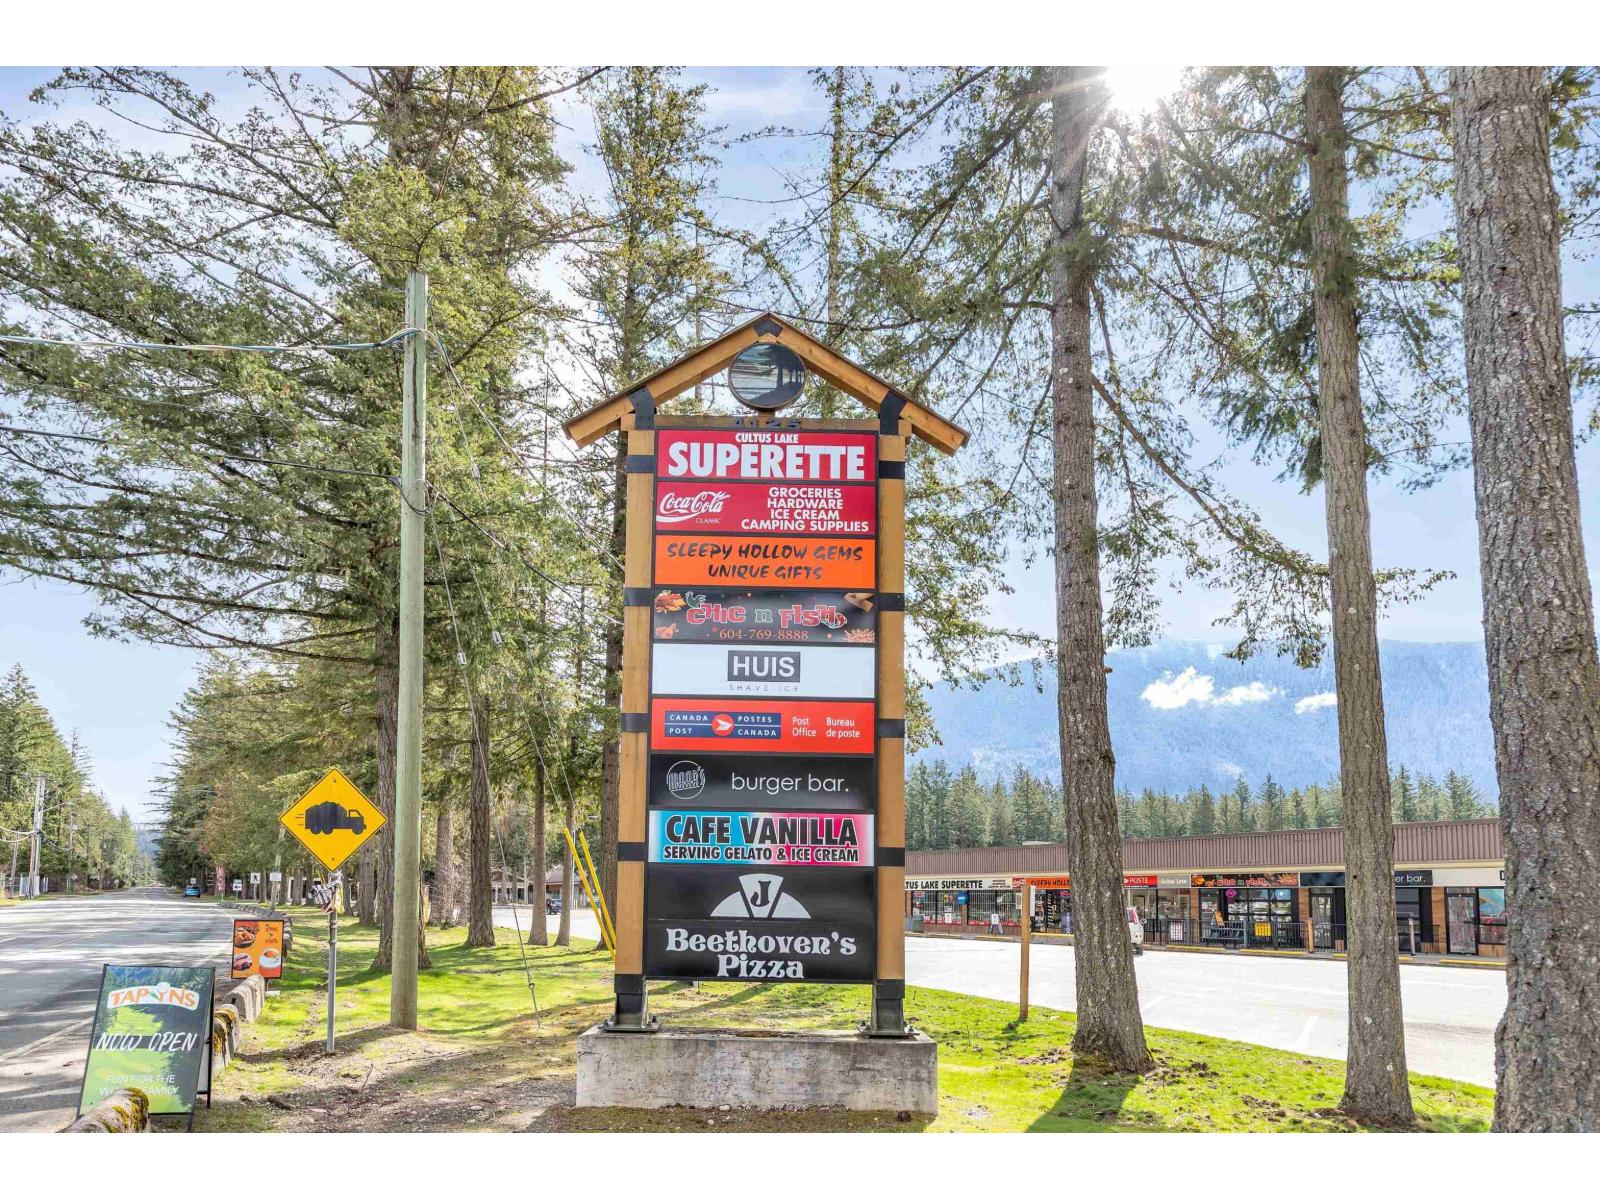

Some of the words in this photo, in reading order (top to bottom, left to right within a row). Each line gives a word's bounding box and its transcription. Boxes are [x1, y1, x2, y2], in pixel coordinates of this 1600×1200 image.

[735, 432, 772, 443] CULTUS
[774, 433, 799, 443] LAKE
[668, 441, 865, 480] SUPERETTE
[768, 487, 842, 499] GROCERIES
[767, 498, 843, 510] HARDWARE
[770, 509, 790, 520] ICE
[793, 510, 840, 521] CREAM
[741, 519, 805, 531] CAMPING
[809, 520, 869, 532] SUPPLIES
[667, 542, 733, 559] SLEEPY
[738, 543, 808, 559] HOLLOW
[813, 545, 863, 561] GEMS
[708, 564, 769, 579] UNIQUE
[774, 565, 823, 580] GIFTS
[719, 629, 809, 641] 604-769-8888
[733, 655, 795, 678] HUIS
[729, 684, 769, 692] SHAVE
[792, 717, 809, 726] Post
[826, 717, 855, 727] Bureau
[792, 727, 817, 737] Office
[826, 728, 837, 737] de
[838, 729, 861, 739] poste
[731, 773, 801, 795] burger
[808, 773, 849, 793] bar.
[665, 815, 730, 845] CAFE
[738, 816, 859, 847] VANILLA
[664, 846, 720, 860] SERVING
[724, 846, 772, 861] GELATO
[776, 847, 788, 861] &
[791, 847, 811, 861] ICE
[814, 848, 859, 862] CREAM
[905, 880, 918, 889] TUS
[921, 880, 939, 889] LAKE
[941, 879, 983, 889] SUPERETTE
[1406, 874, 1426, 883] bar.
[751, 880, 771, 907] J
[666, 927, 857, 955] Beethoven's
[717, 954, 804, 979] Pizza
[95, 1031, 144, 1051] NOW
[148, 1031, 198, 1052] OPEN
[157, 1074, 176, 1083] THE
